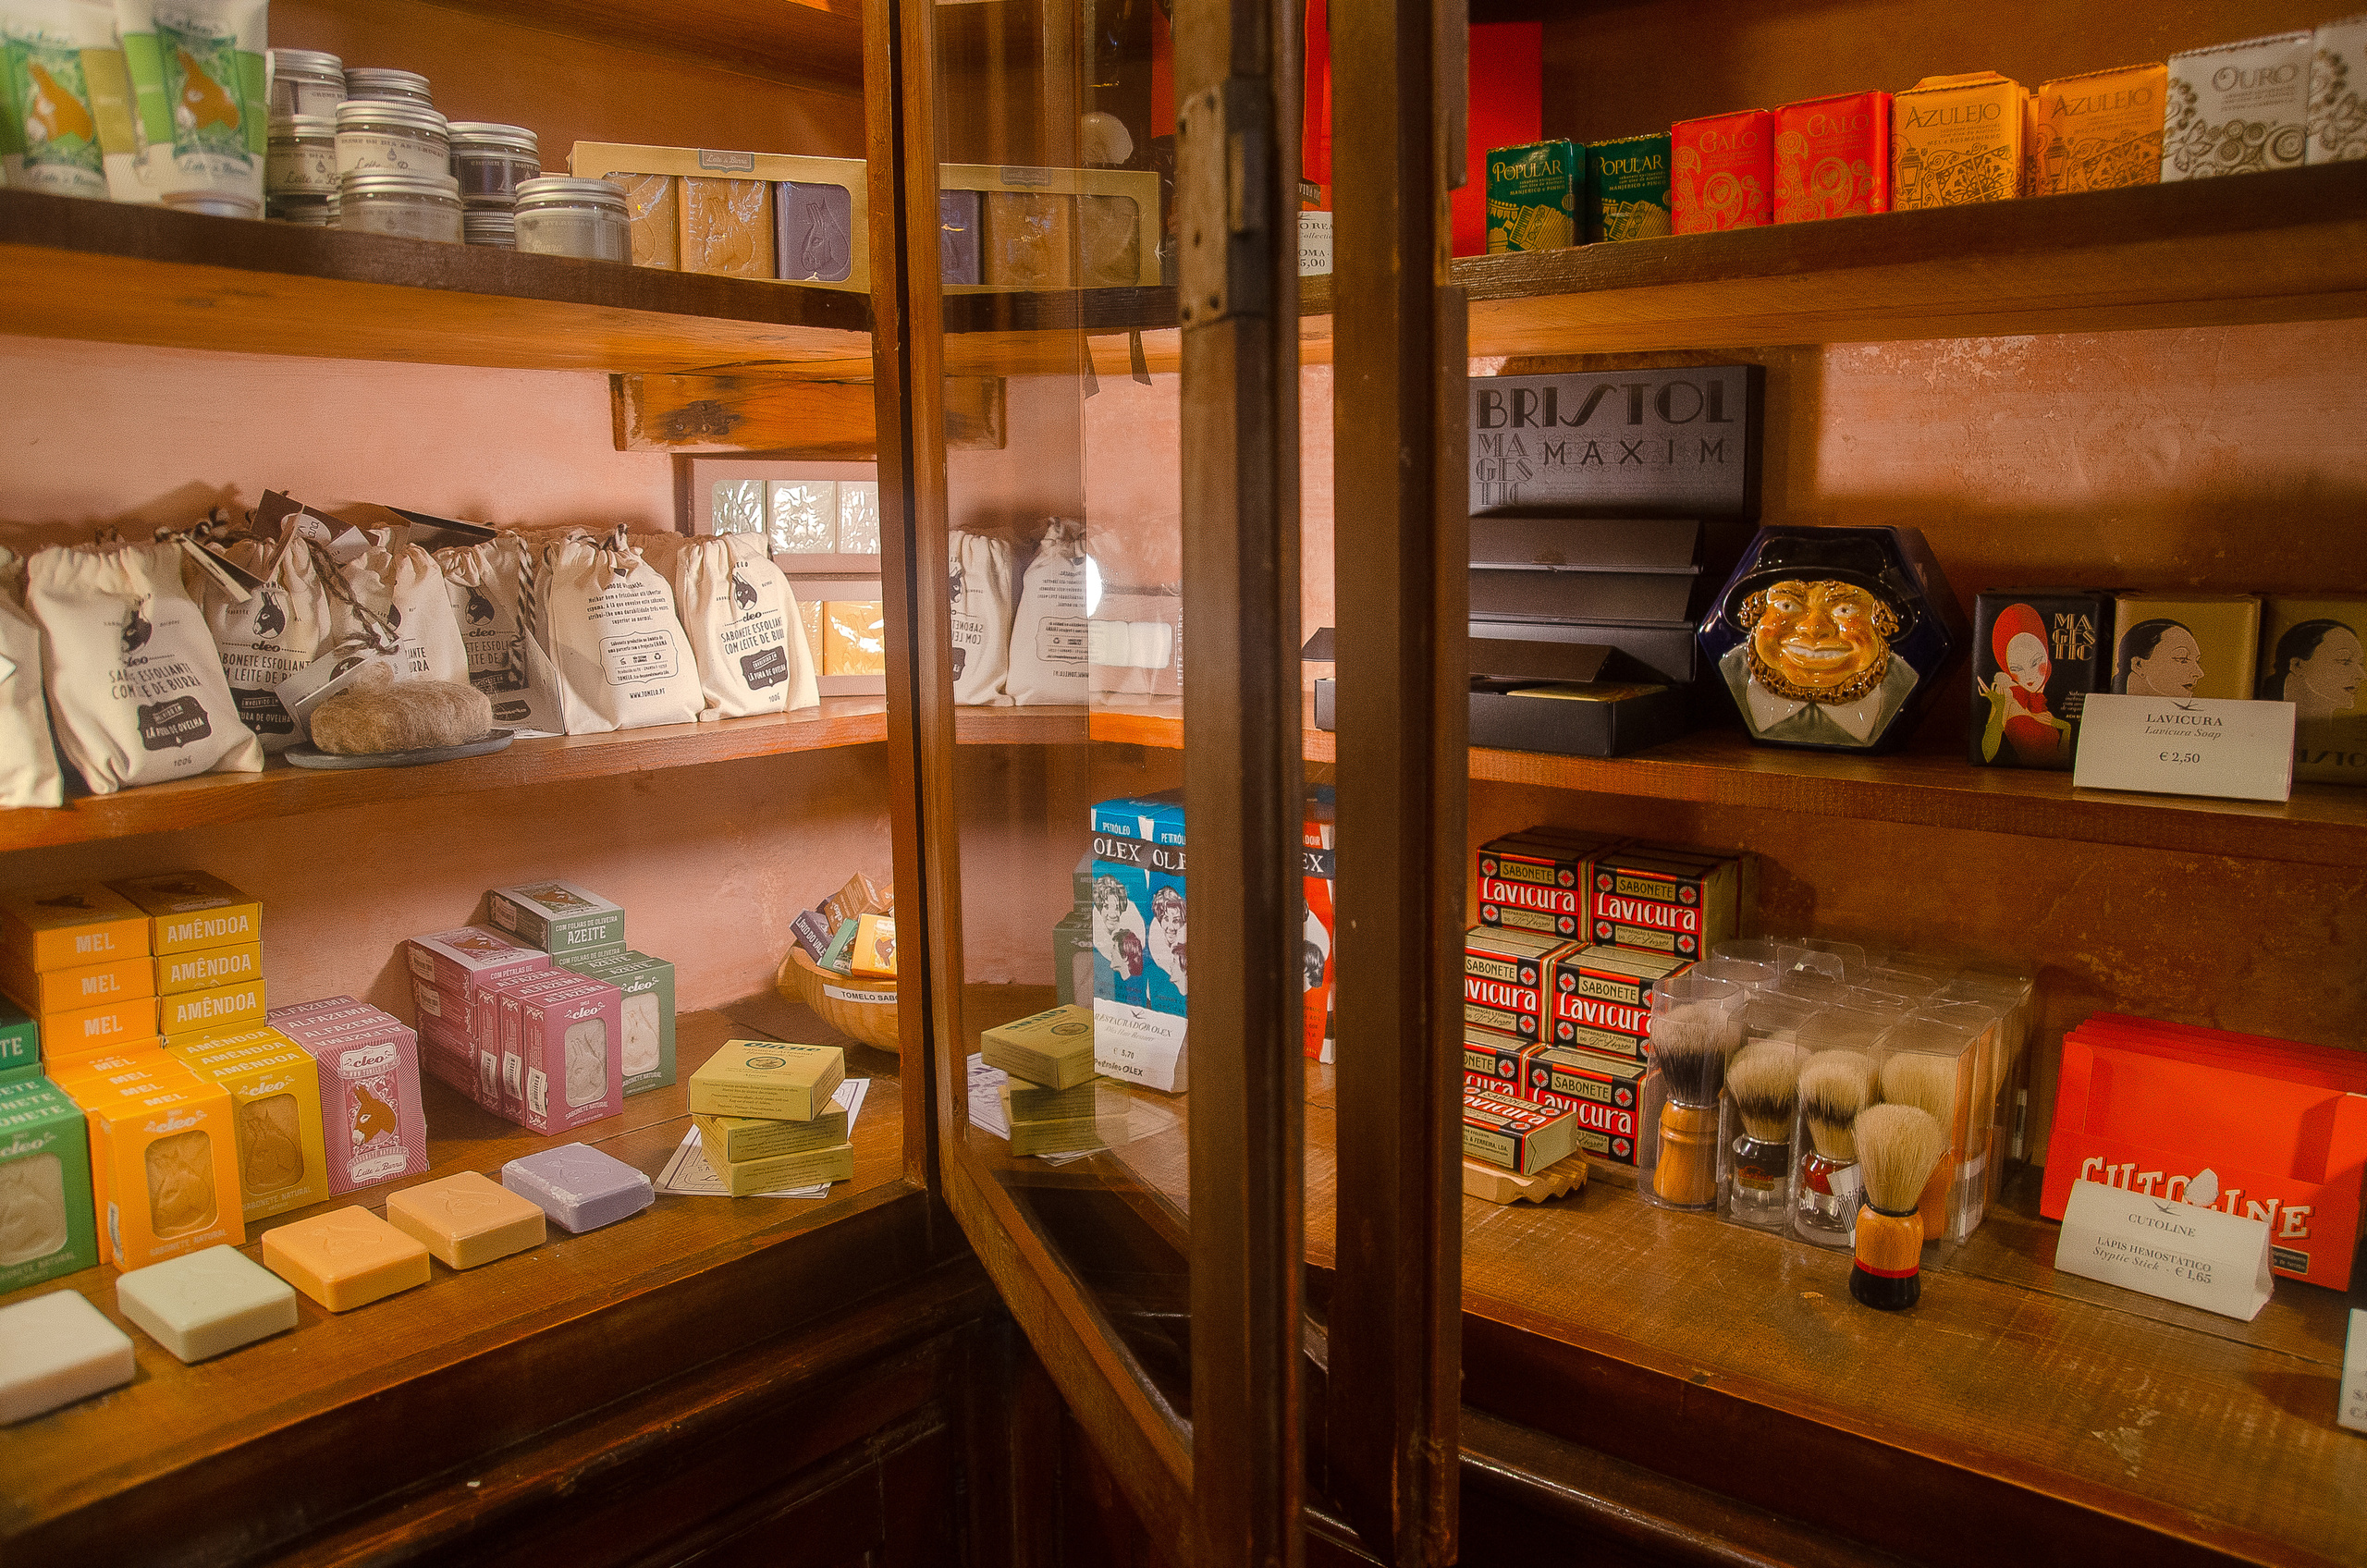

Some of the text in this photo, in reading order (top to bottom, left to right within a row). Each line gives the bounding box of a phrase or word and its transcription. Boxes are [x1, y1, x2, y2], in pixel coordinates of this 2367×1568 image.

[2213, 63, 2300, 92] OURO
[2051, 88, 2152, 119] AZULEJO
[1807, 114, 1870, 138] GALO
[1905, 103, 2001, 129] AZULEJO
[1699, 130, 1758, 153] GALO
[1492, 159, 1563, 182] POPULAR
[1600, 154, 1663, 176] POPULAR
[1476, 380, 1735, 429] BRISTOL
[1477, 433, 1529, 458] MA
[1542, 437, 1725, 466] MAXIM
[742, 610, 763, 623] cleo
[2054, 612, 2092, 630] MA
[468, 628, 497, 638] cleo
[720, 616, 783, 643] SABONETE ESFOLIANT
[2052, 629, 2096, 645] GES
[251, 640, 281, 653] cleo
[724, 632, 771, 655] COM LEITE DE
[2051, 643, 2093, 661] TIC
[220, 653, 313, 672] BONETE ESFOLIANT
[235, 668, 277, 684] LEITE DE
[240, 711, 254, 721] URA
[2145, 713, 2223, 727] LAVICURA
[2144, 726, 2222, 741] Lavicura Soap
[2159, 752, 2201, 766] € 2,50
[1102, 821, 1131, 836] PETRÓLEO
[1160, 832, 1186, 845] PETRÓL
[1093, 837, 1142, 863] OLEX
[1152, 849, 1186, 870] OLE
[1502, 864, 1553, 884] SABONETE
[1482, 876, 1576, 913] Lavicura
[1618, 879, 1674, 899] SABONETE
[1597, 891, 1697, 931] Lavicura
[166, 914, 250, 943] AMÊNDOA
[555, 914, 619, 932] COM FOLHAS DE OLIVEIRA
[75, 932, 116, 954] MEL
[567, 925, 607, 945] AZEITE
[794, 916, 828, 958] LÍRIO DO VALE
[558, 948, 620, 966] COM FOLHAS DE OLIVEIRA
[586, 955, 632, 969] AZEITE
[170, 953, 252, 983] AMÊNDOA
[490, 964, 533, 980] COM PÉTALAS DE
[608, 962, 655, 975] AZEITE
[1466, 959, 1515, 979] SABONETE
[80, 974, 120, 996] MEL
[497, 971, 562, 987] ALFAZEMA
[520, 977, 585, 996] ALFAZEMA
[626, 981, 653, 994] cleo
[544, 985, 607, 1004] ALFAZEMA
[840, 990, 876, 1001] TOMELO
[1465, 977, 1538, 1011] vicura
[1581, 980, 1637, 1001] SABONETE
[177, 991, 257, 1023] AMÊNDOA
[268, 997, 351, 1019] ALFAZEMA
[571, 1008, 599, 1020] cleo
[83, 1014, 123, 1037] MEL
[288, 1006, 372, 1029] ALFAZEMA
[303, 1015, 389, 1039] ALFAZEMA
[1095, 1012, 1173, 1037] RESTAURADOR OLEX
[313, 1025, 404, 1047] ALFAZEMA
[93, 1057, 137, 1072] MEL
[352, 1053, 385, 1069] cleo
[1122, 1065, 1144, 1077] OLEX
[108, 1071, 153, 1085] MEL
[1554, 1076, 1609, 1099] SABONETE
[119, 1083, 165, 1097] MEL
[247, 1081, 287, 1097] cleo
[142, 1092, 189, 1107] MEL
[1482, 1091, 1537, 1109] SABONETE
[1464, 1095, 1548, 1126] avicura
[156, 1115, 196, 1134] cleo
[2081, 1156, 2312, 1239] CUTOINE
[2128, 1212, 2197, 1238] CUTOLINE
[2096, 1235, 2213, 1273] LÁPIS HEMOSTÁTICO
[2092, 1245, 2213, 1285] Styptic Stick € 1,65
